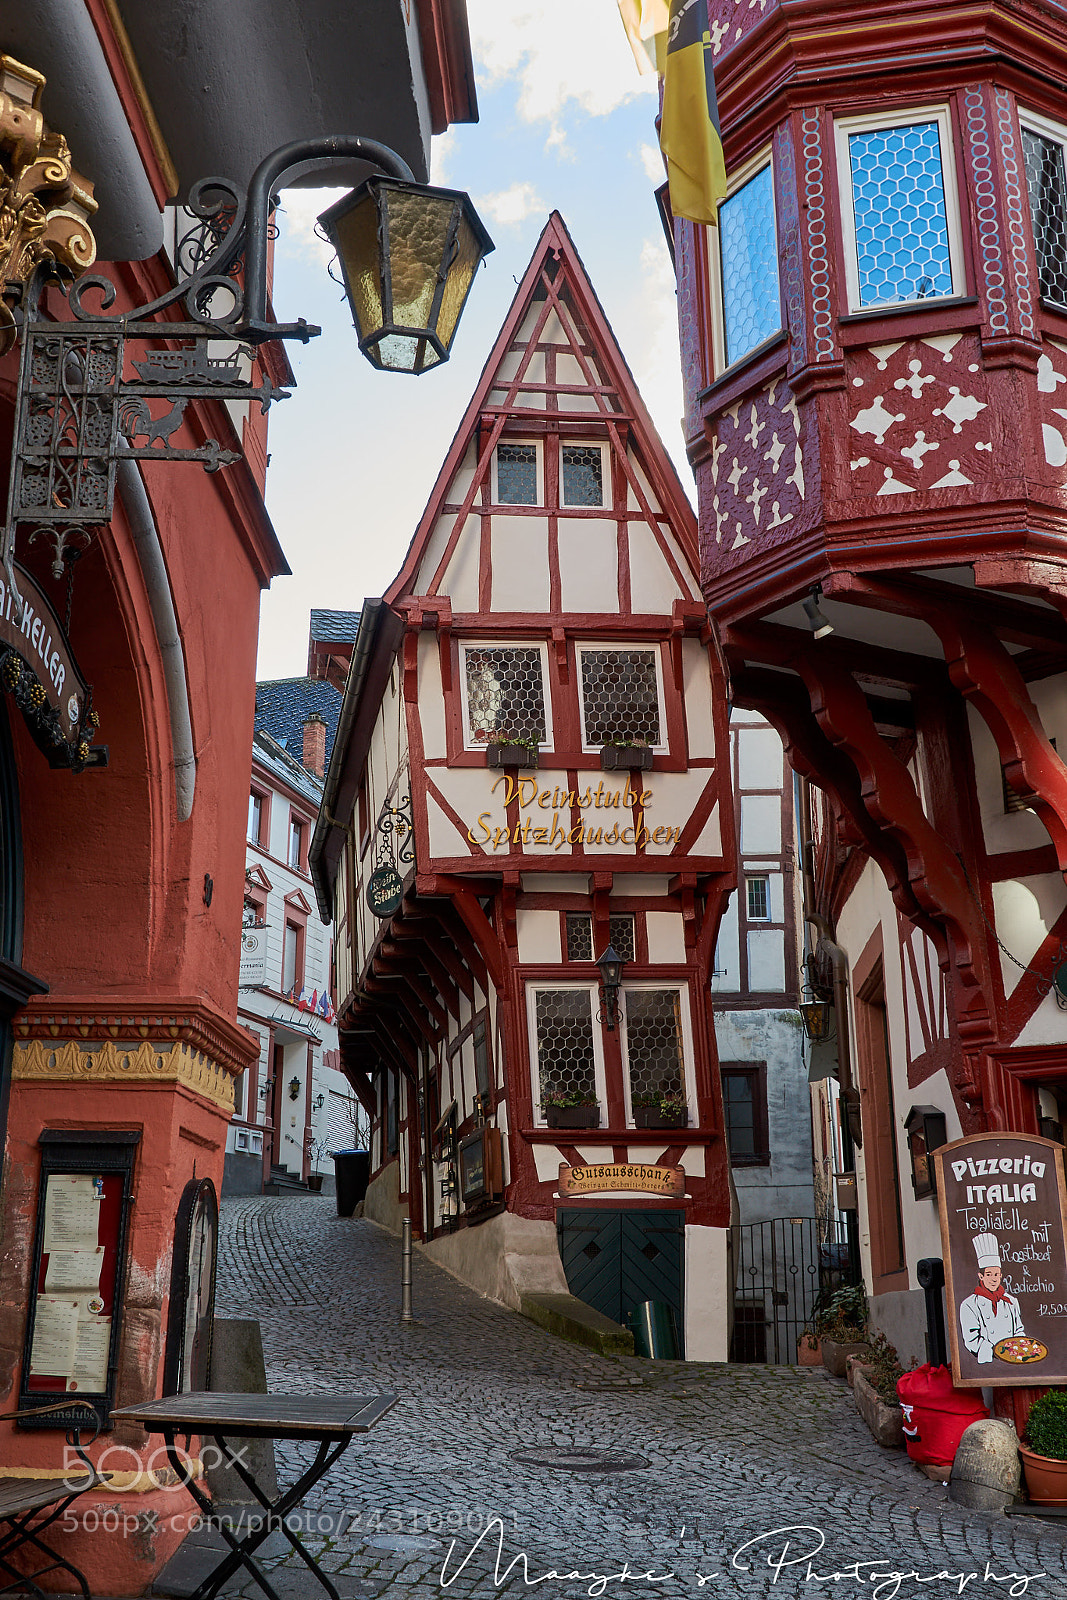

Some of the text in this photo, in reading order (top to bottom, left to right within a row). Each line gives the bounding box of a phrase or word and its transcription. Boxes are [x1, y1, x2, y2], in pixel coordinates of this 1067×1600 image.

[491, 775, 653, 809] Weinstube
[467, 812, 681, 850] Spitzhäuschen
[571, 1165, 671, 1184] Gutsausschank
[951, 1155, 1046, 1182] Pizzeria
[966, 1183, 1037, 1205] ITALIA
[956, 1206, 1052, 1243] Tagliatelle mit
[1022, 1264, 1032, 1277] &
[1003, 1274, 1055, 1294] Radicchio
